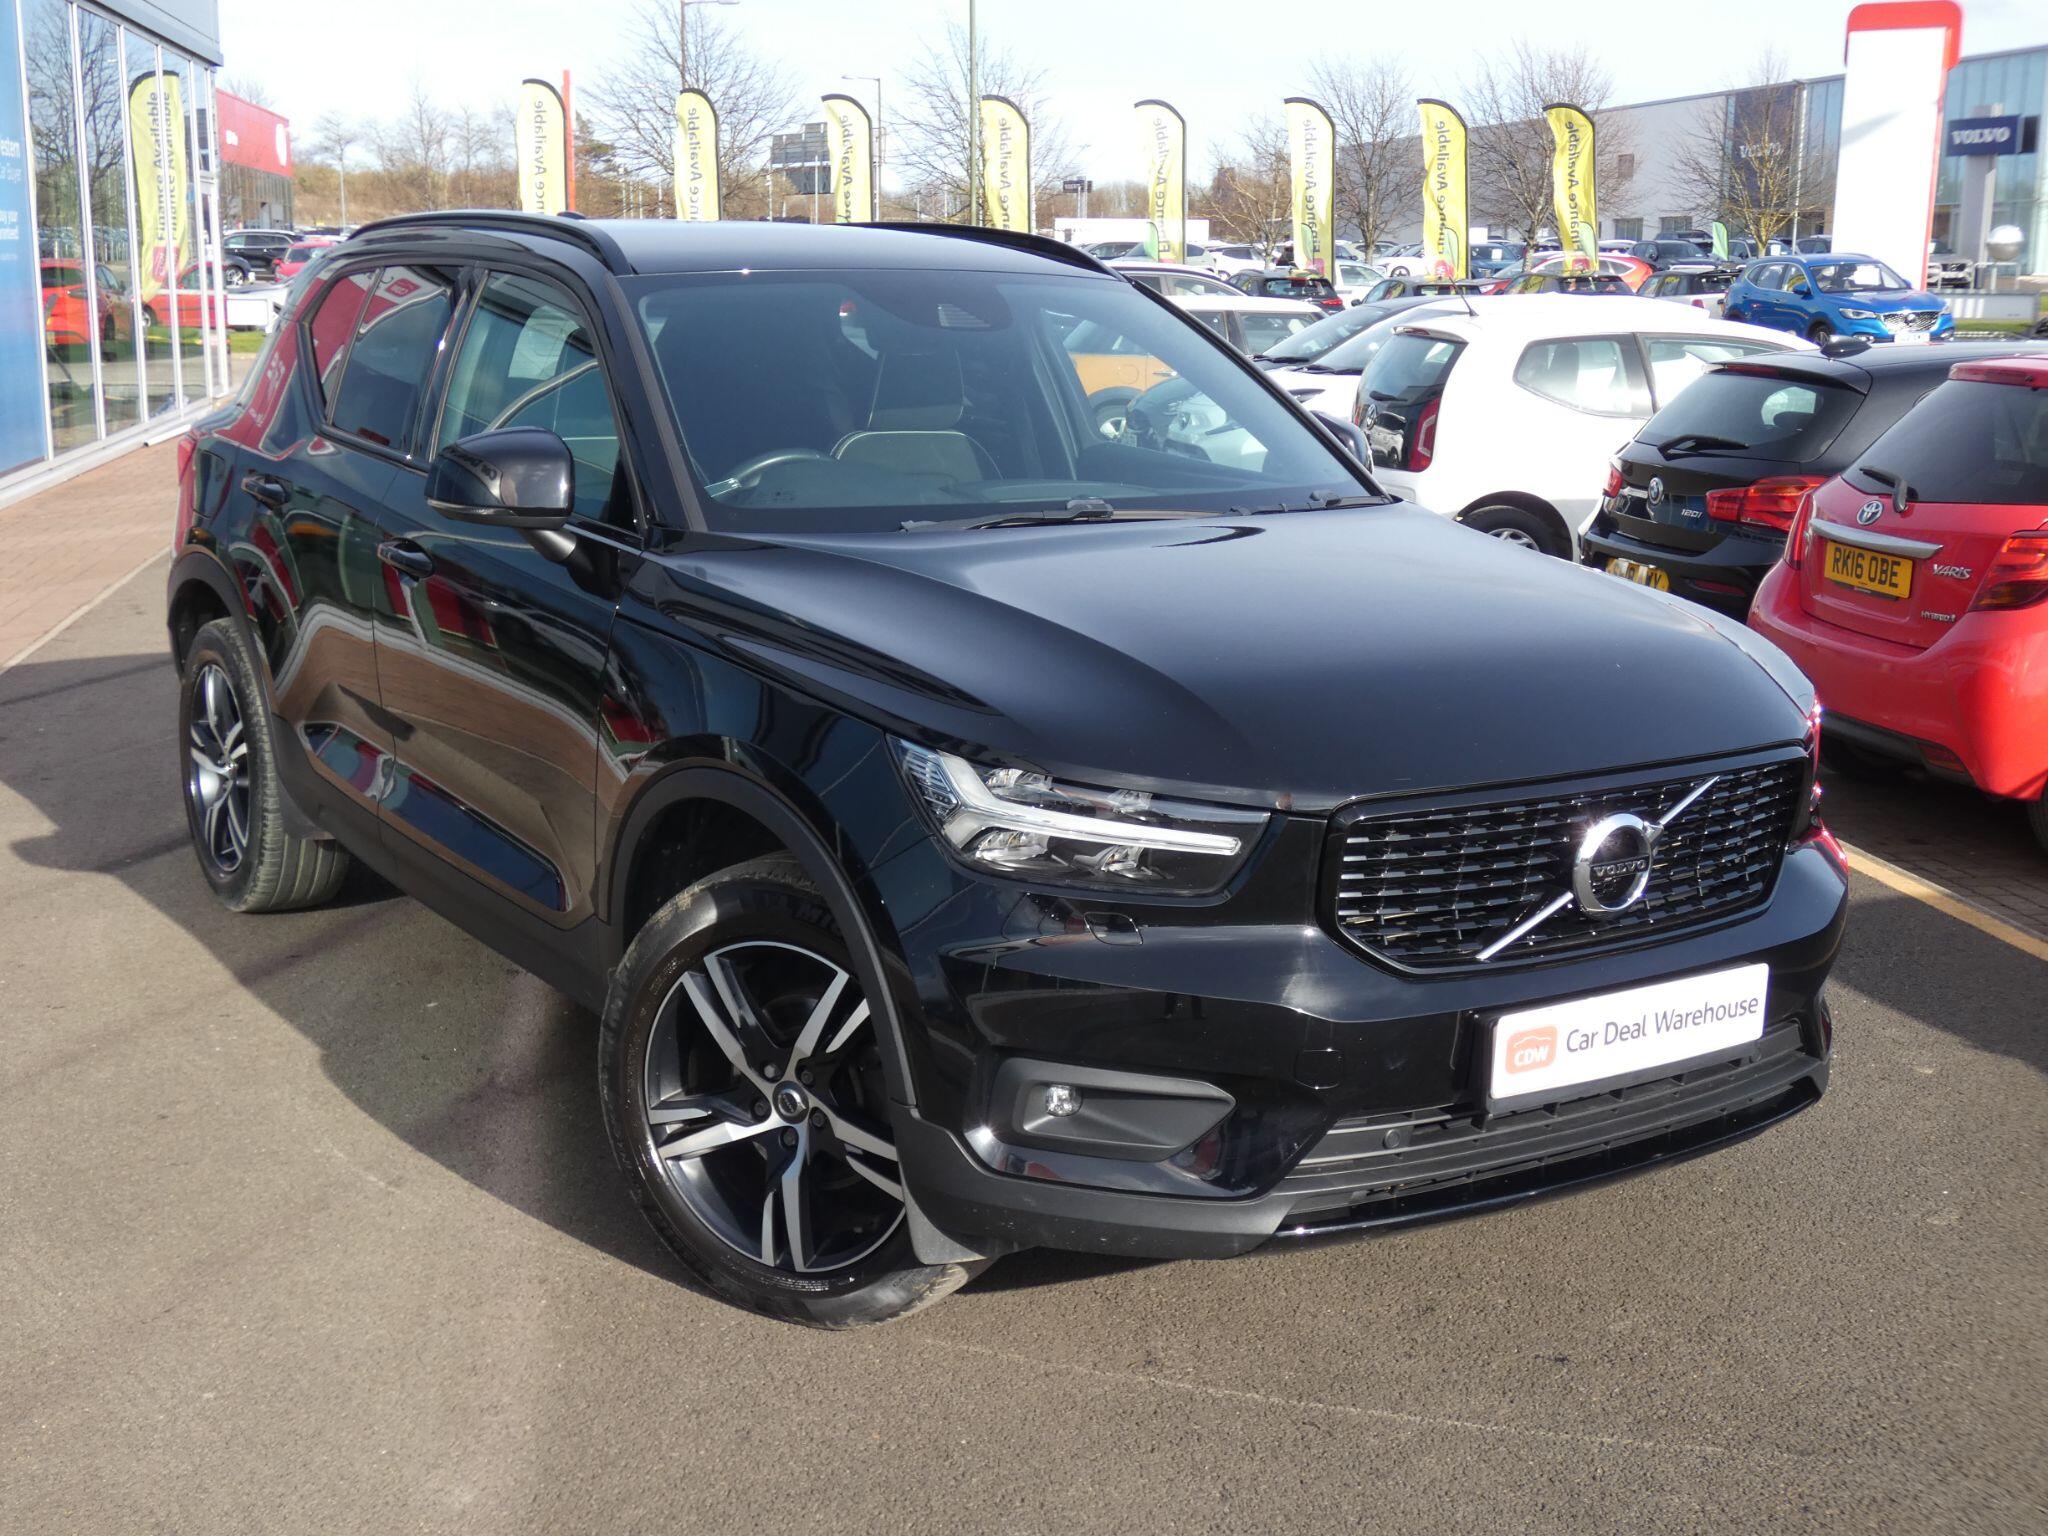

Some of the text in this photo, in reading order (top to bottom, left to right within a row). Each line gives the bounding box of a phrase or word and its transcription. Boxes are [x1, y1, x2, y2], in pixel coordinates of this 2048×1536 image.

[147, 92, 162, 169] Available
[1951, 126, 2011, 145] VOLVO
[1832, 546, 1902, 589] RK16 OBE
[1593, 859, 1646, 877] VOLVO
[1566, 996, 1760, 1053] Car Deal Warehouse
[1513, 1045, 1549, 1068] CDW
